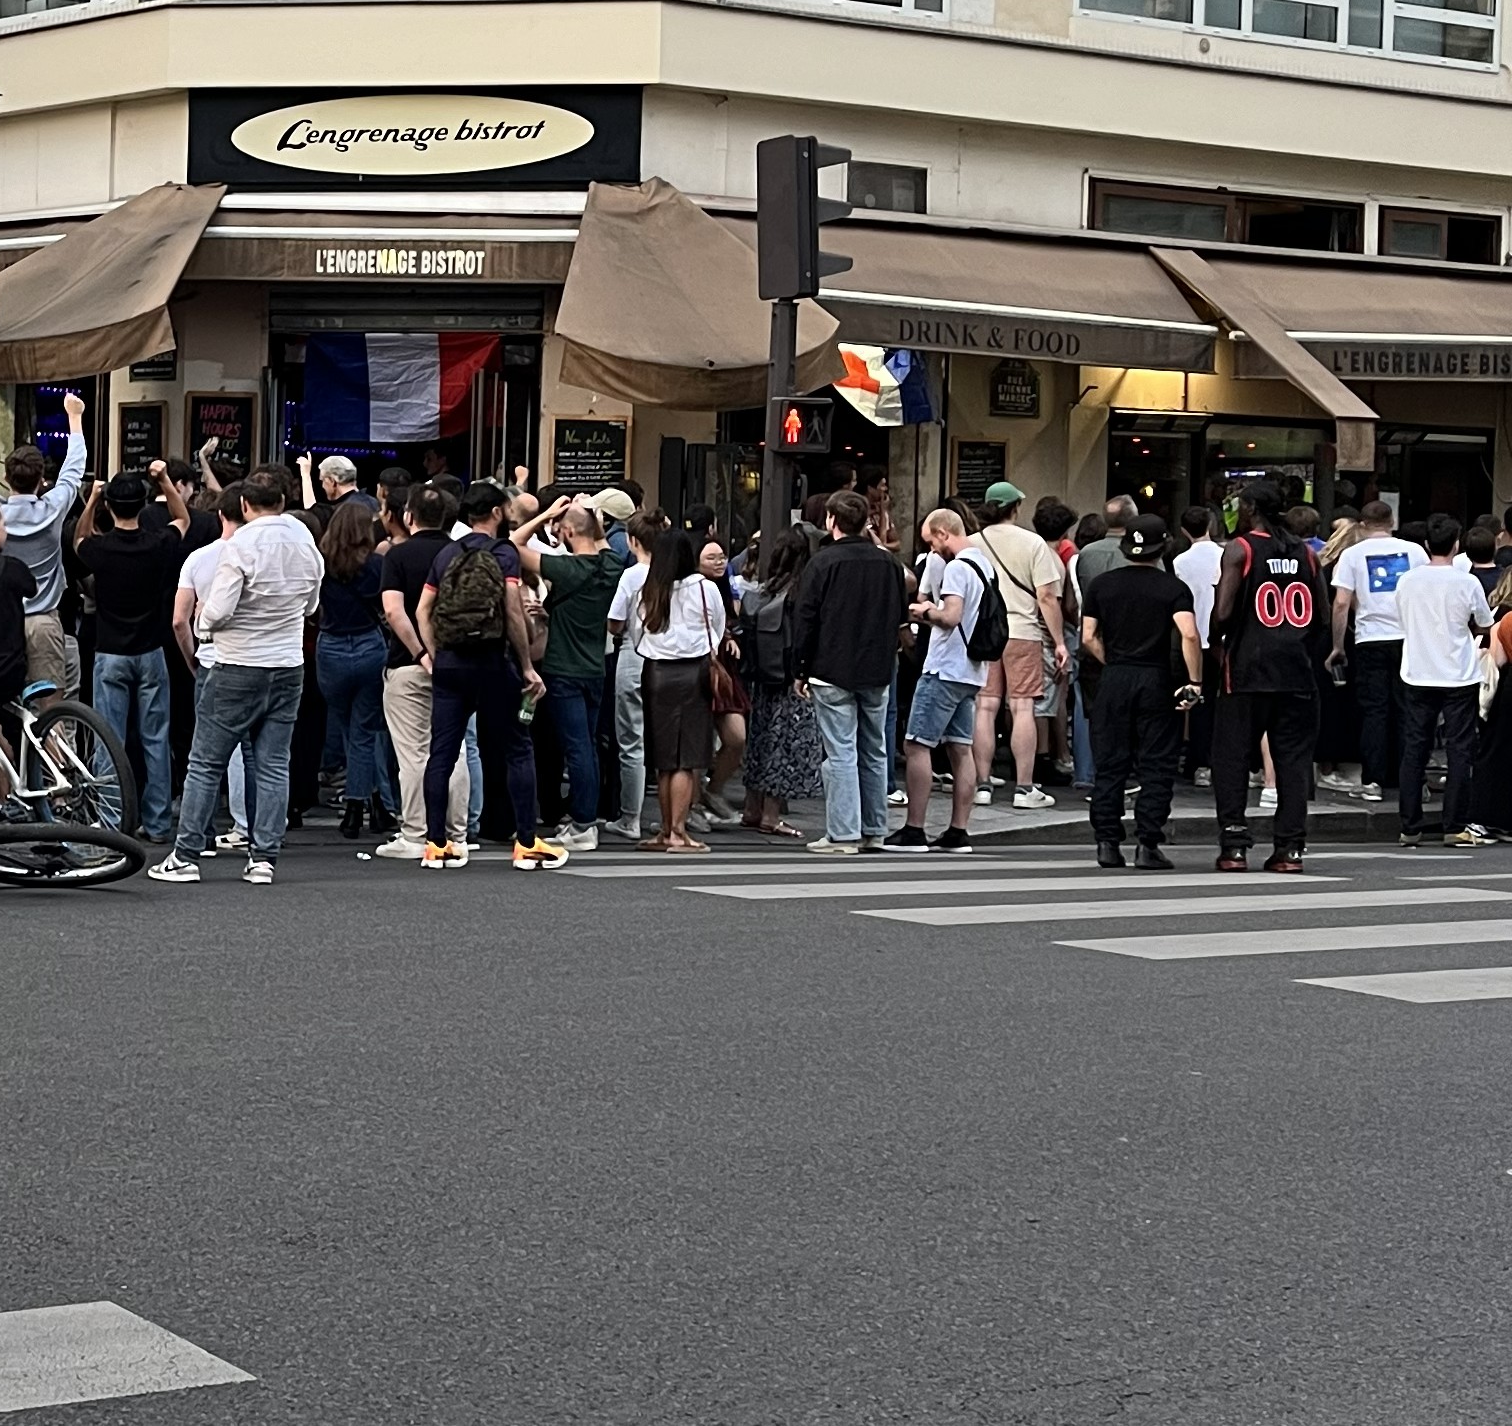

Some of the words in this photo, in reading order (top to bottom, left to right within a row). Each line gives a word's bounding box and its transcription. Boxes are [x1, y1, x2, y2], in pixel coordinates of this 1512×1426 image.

[277, 119, 448, 152] L'engrenage
[454, 119, 546, 141] bistrot
[315, 248, 417, 274] L'ENGRENAGE
[421, 250, 486, 274] BISTROT
[899, 318, 979, 347] DRINK
[987, 325, 1004, 349] &
[1014, 328, 1081, 357] FOOD
[1333, 350, 1471, 374] L'ENGRENAGE
[200, 404, 239, 421] HAPPY
[202, 422, 242, 438] HOURS
[1255, 581, 1313, 628] 00
